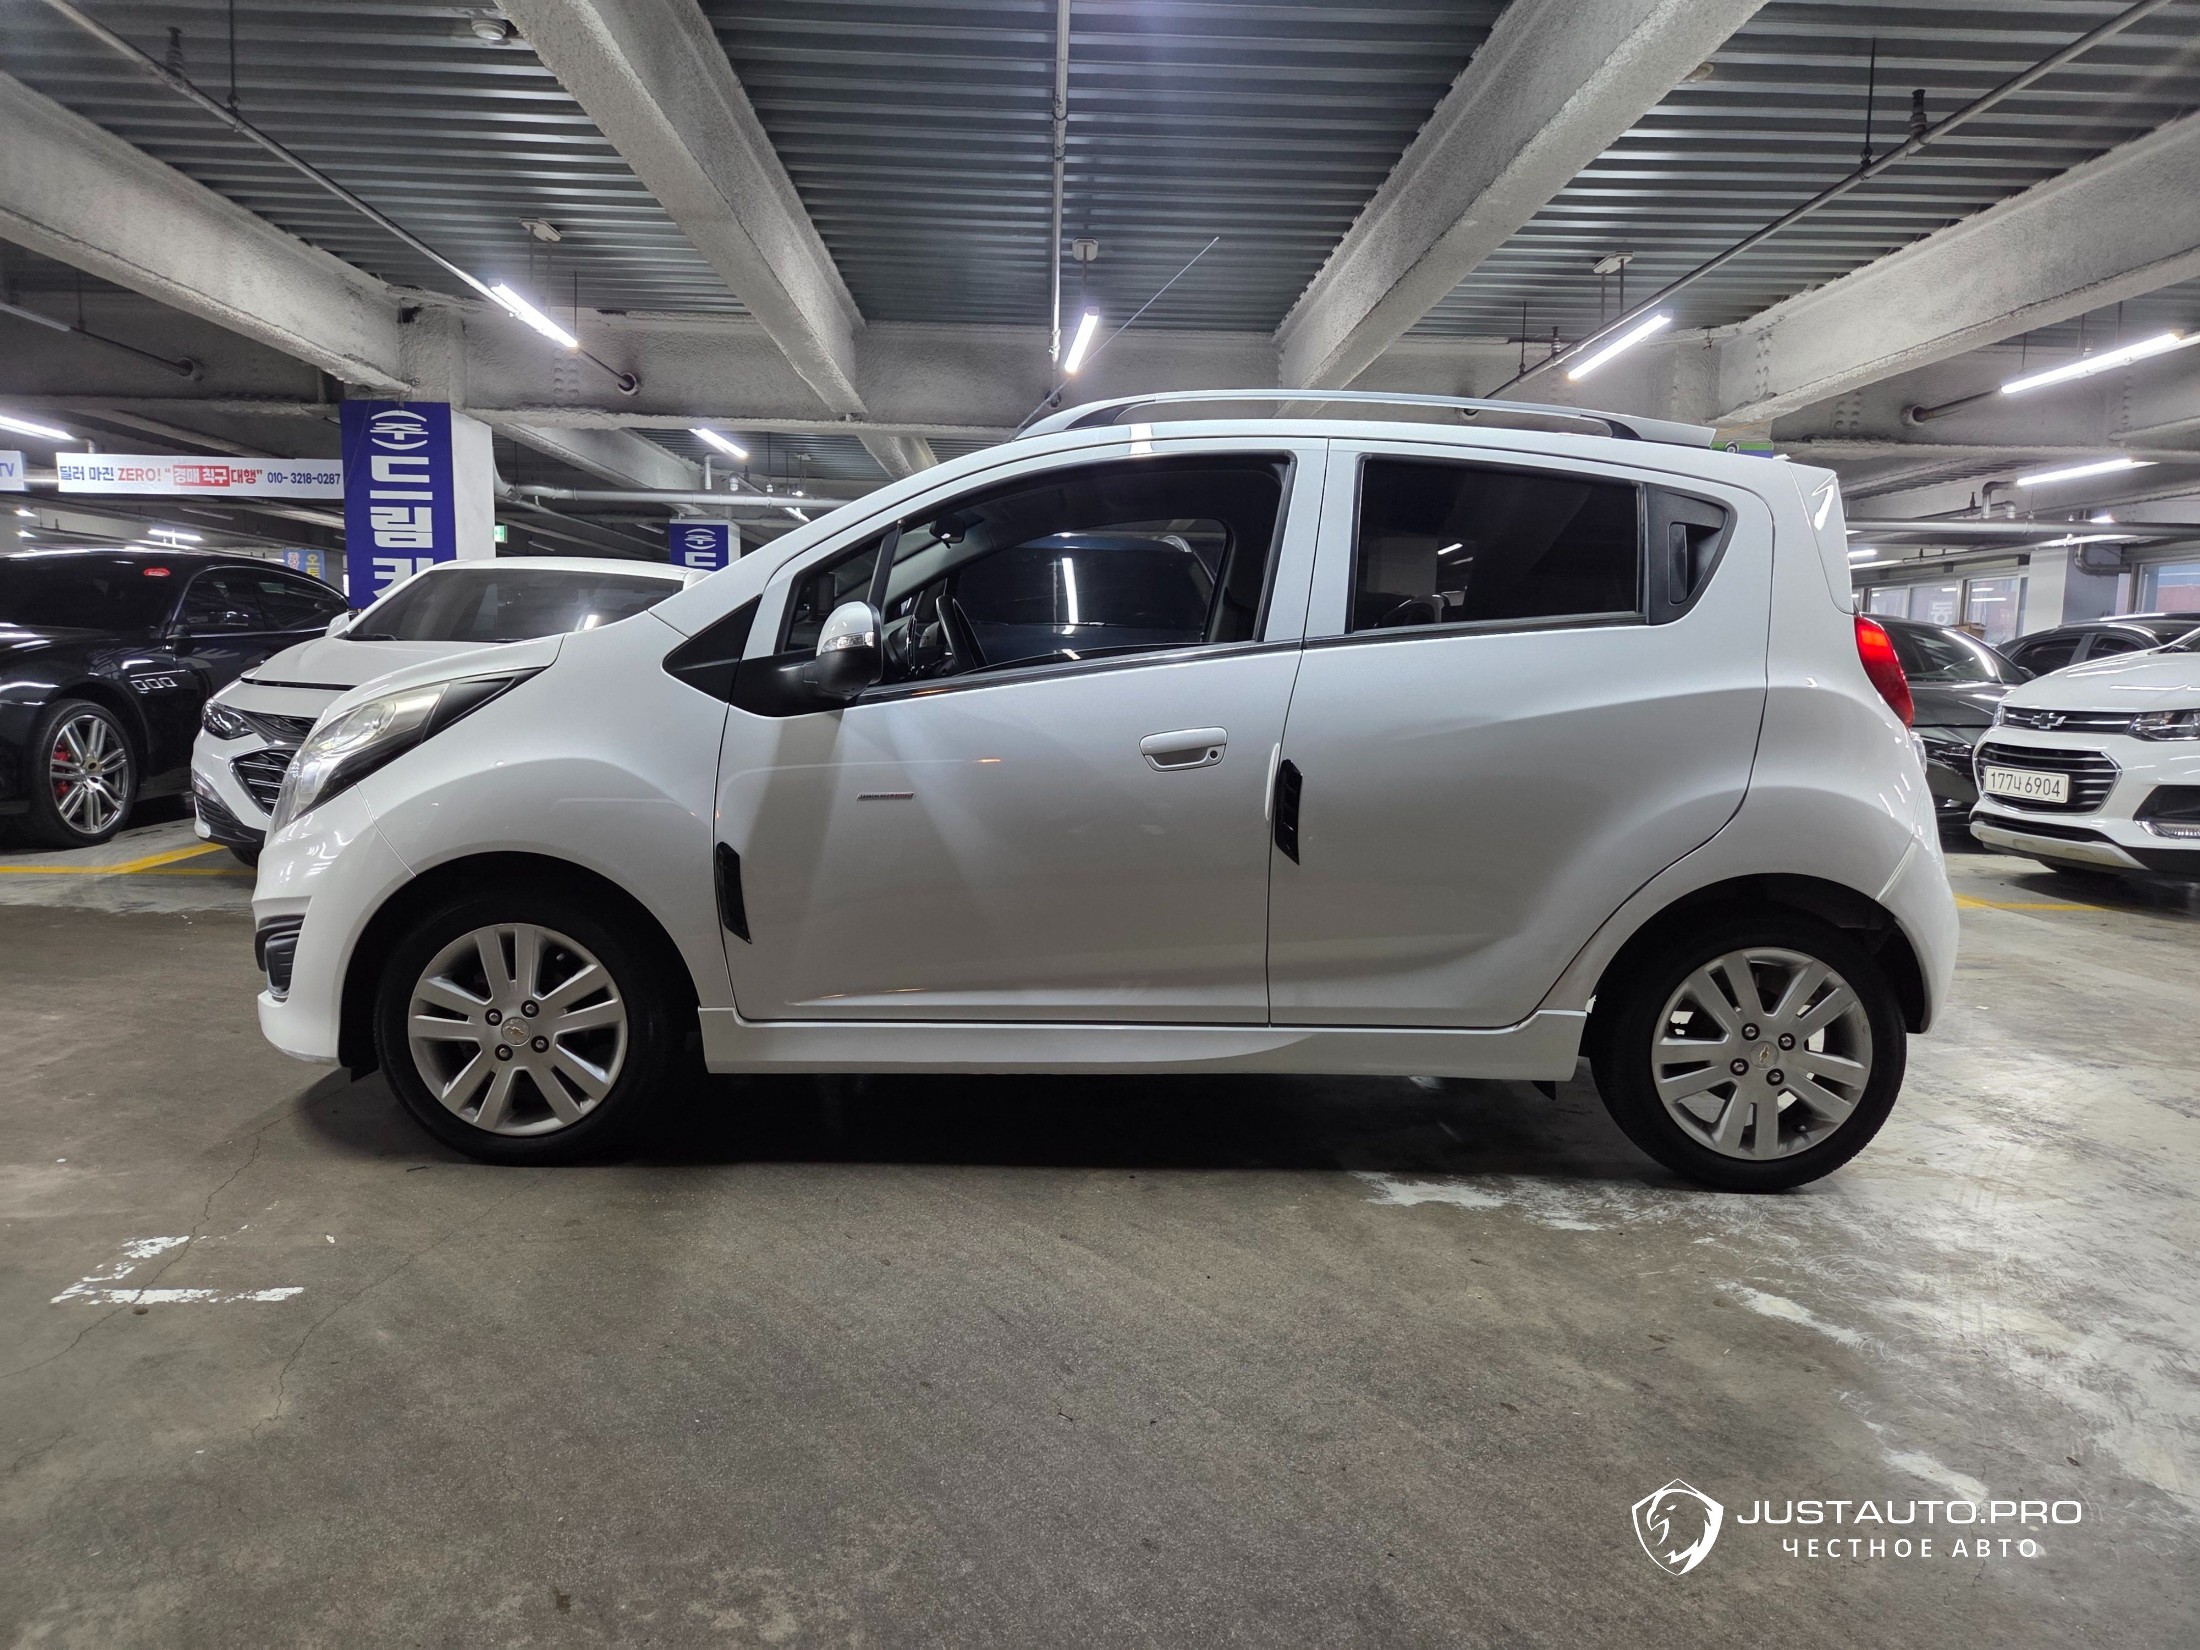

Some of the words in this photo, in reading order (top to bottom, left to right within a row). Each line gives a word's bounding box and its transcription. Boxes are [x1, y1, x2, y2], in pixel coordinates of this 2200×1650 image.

[60, 465, 85, 481] 딜러
[89, 466, 115, 482] 마진
[117, 468, 161, 482] ZERO!
[2024, 776, 2061, 797] 6904
